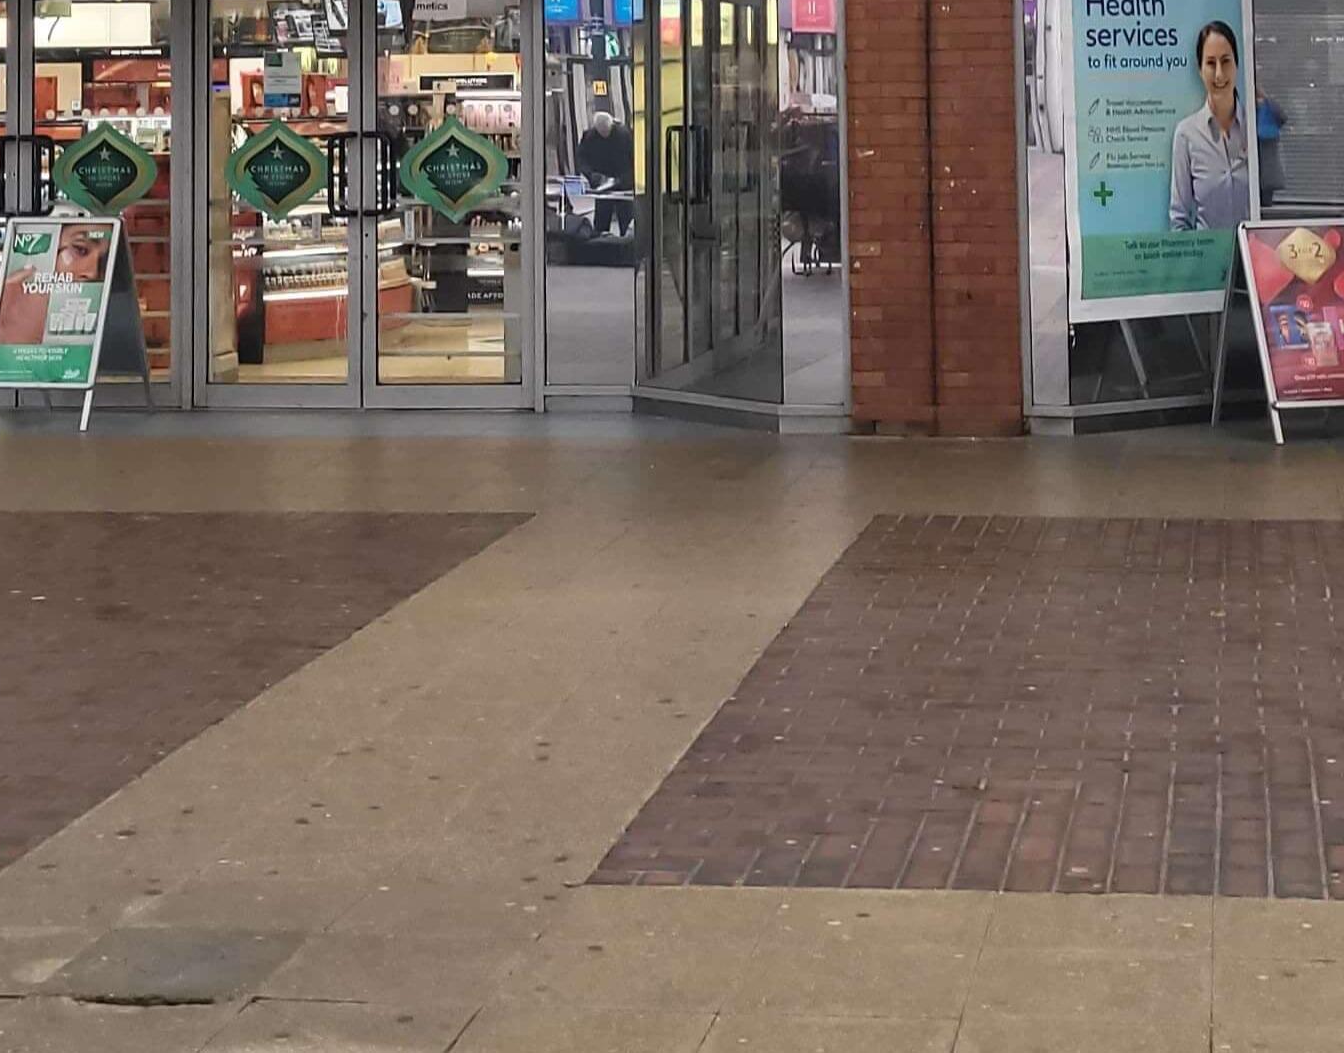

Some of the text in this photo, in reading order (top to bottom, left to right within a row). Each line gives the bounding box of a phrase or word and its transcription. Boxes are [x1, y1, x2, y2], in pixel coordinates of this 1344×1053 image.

[1086, 20, 1178, 47] services
[1088, 53, 1188, 72] to fit around you
[78, 166, 131, 176] CHRISTMAS
[250, 165, 304, 174] CHRISTMAS
[426, 163, 482, 173] CHRISTMAS
[1288, 244, 1298, 259] 3
[1312, 243, 1323, 258] 2
[34, 272, 74, 283] REHAB
[22, 282, 82, 294] YOUR SKIN
